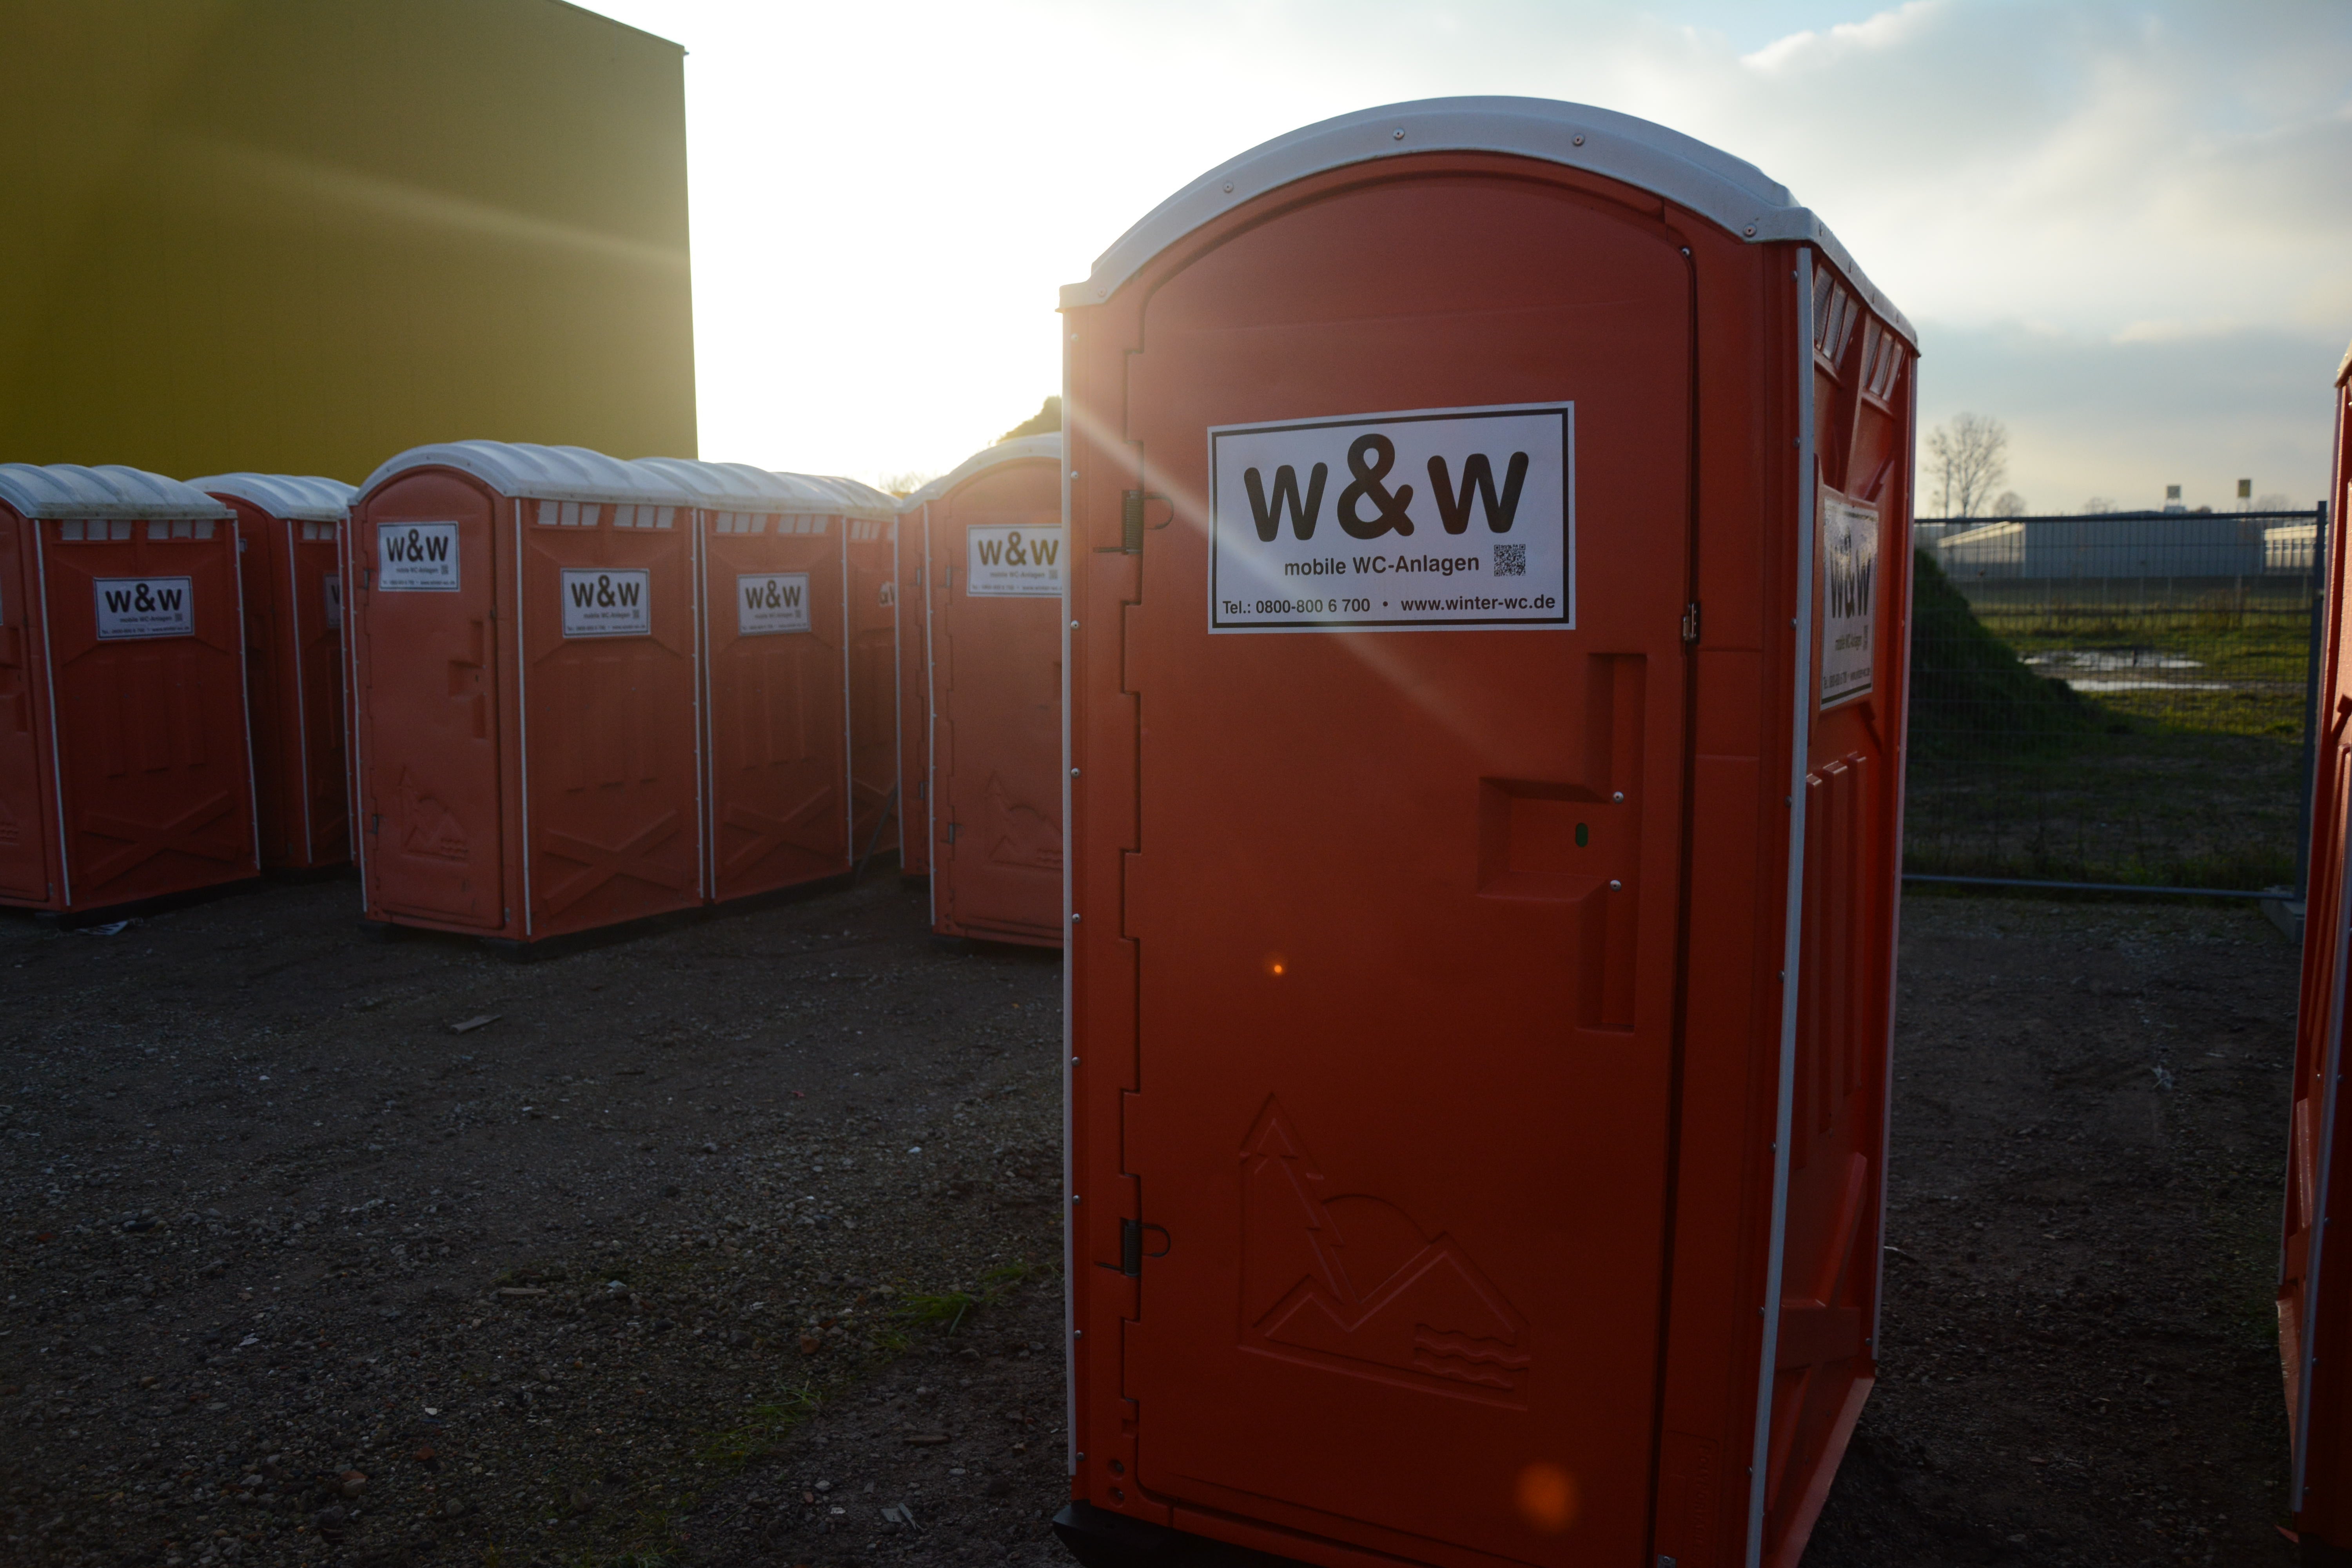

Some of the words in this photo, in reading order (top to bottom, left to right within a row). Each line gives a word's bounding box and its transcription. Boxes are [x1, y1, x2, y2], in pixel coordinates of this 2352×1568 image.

[1244, 433, 1529, 542] W&W
[387, 529, 448, 562] W&W
[978, 531, 1059, 566] W&W
[1285, 557, 1346, 575] mobile
[1352, 555, 1479, 577] WC-Anlagen
[105, 583, 182, 613] W&W
[571, 575, 640, 607] W&W
[746, 580, 801, 609] W&W
[1222, 601, 1251, 614] Tel.:
[1256, 599, 1323, 613] 0800-800
[1328, 599, 1337, 612] 6
[1342, 598, 1370, 612] 700
[1401, 594, 1555, 611] www.winter-wc.de
